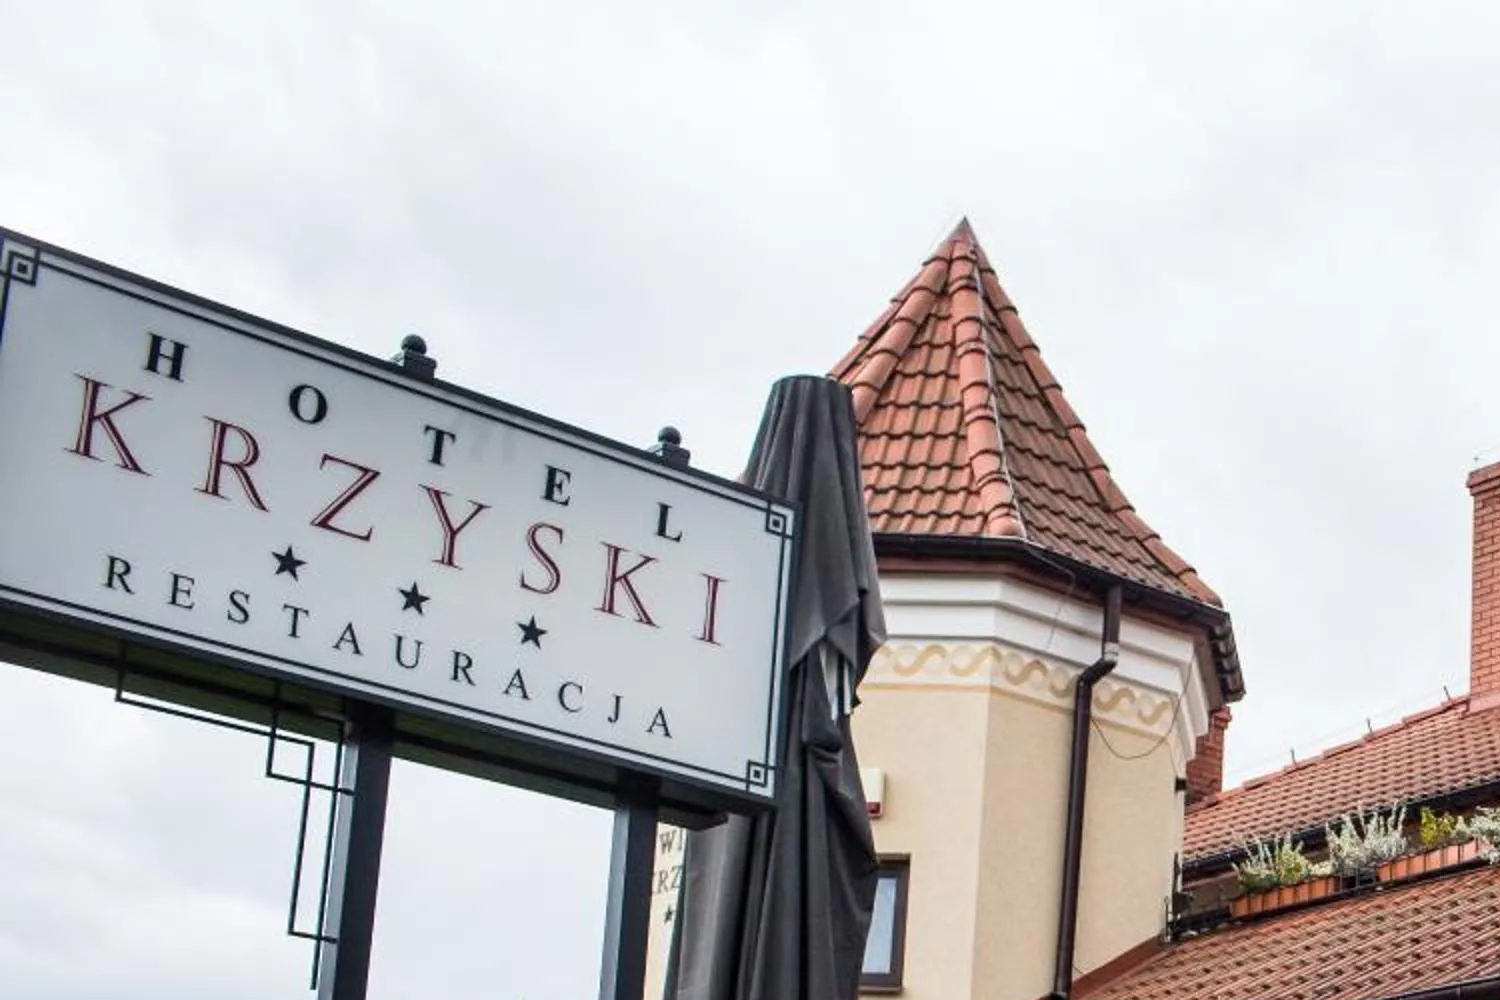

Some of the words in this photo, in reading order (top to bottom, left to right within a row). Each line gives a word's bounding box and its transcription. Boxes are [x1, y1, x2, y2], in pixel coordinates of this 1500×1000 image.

[63, 372, 730, 646] KRZYSKI
[144, 332, 684, 544] HOTEL
[104, 554, 675, 739] RESTAURACJA
